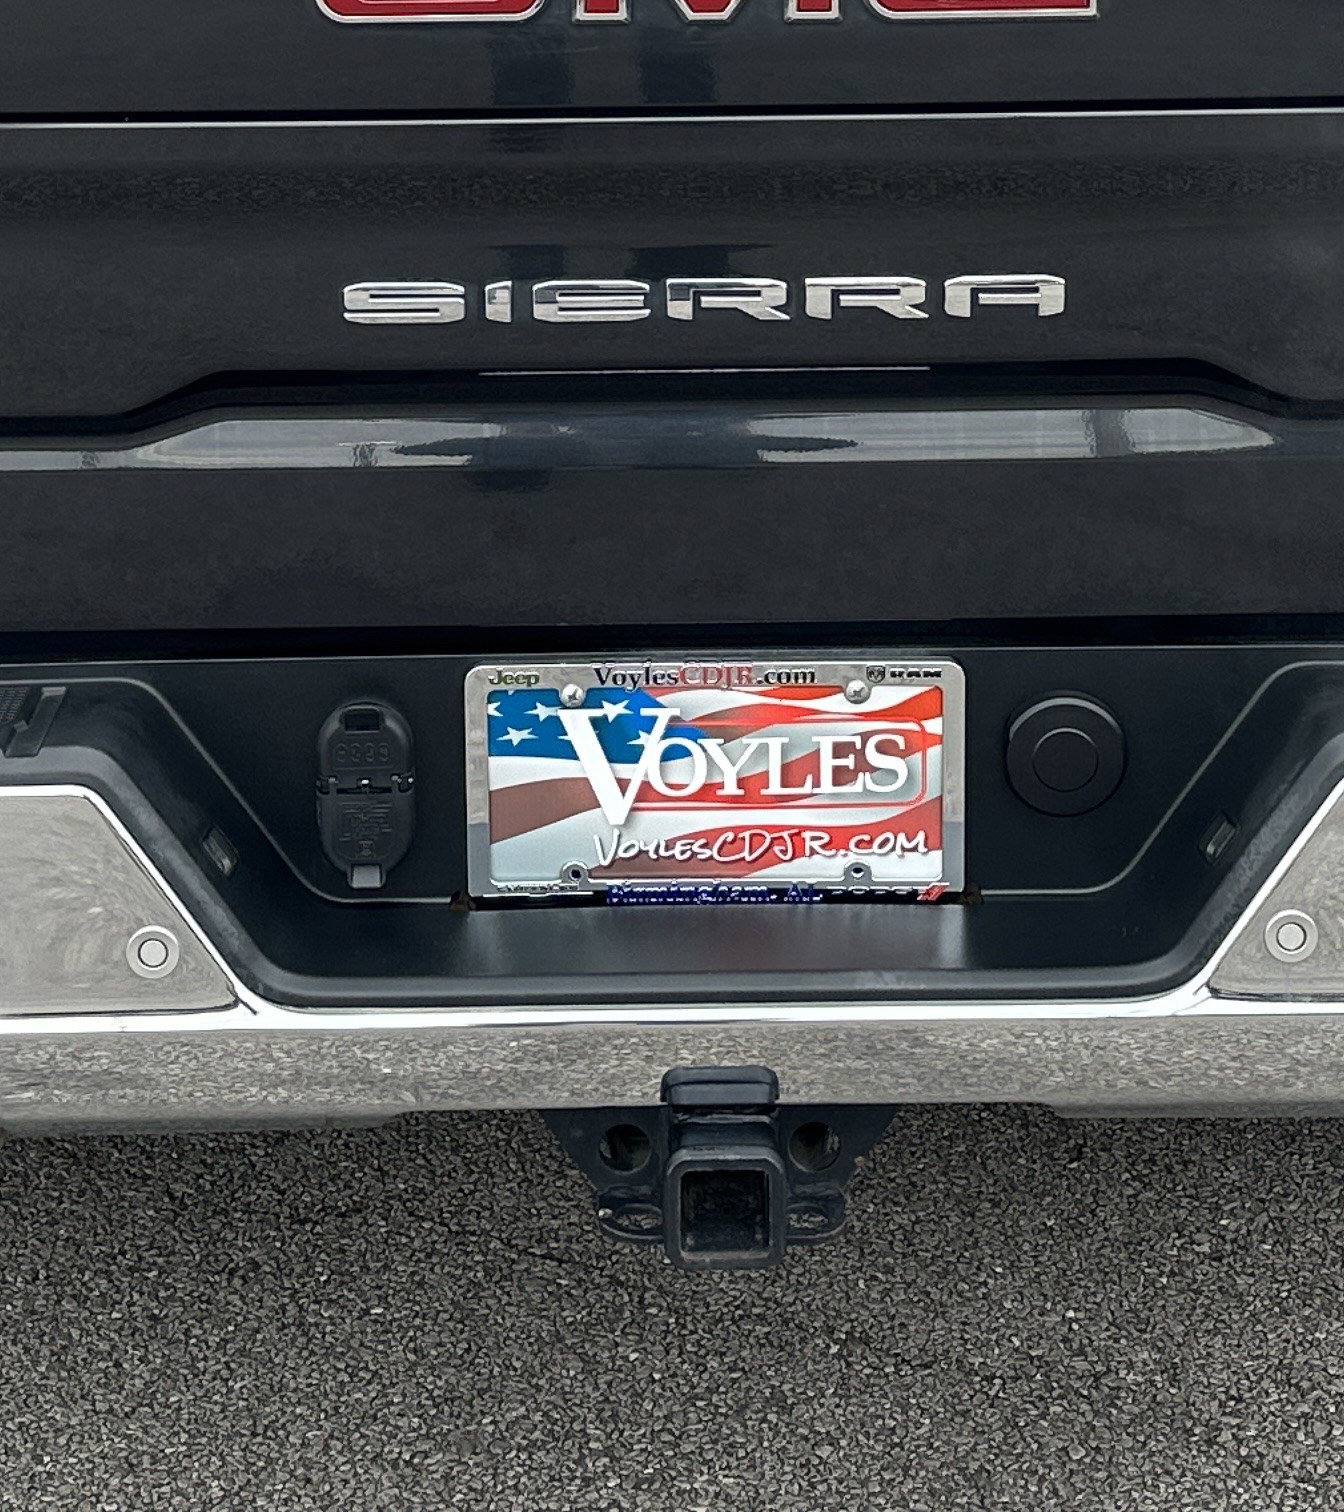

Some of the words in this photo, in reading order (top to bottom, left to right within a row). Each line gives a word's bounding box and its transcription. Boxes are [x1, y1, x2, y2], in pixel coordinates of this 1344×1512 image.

[342, 272, 1066, 324] SIERRA
[488, 667, 540, 687] Jeep
[591, 660, 818, 693] VoylesCDJR.com
[889, 667, 943, 679] RAM
[558, 707, 909, 826] VOYLES
